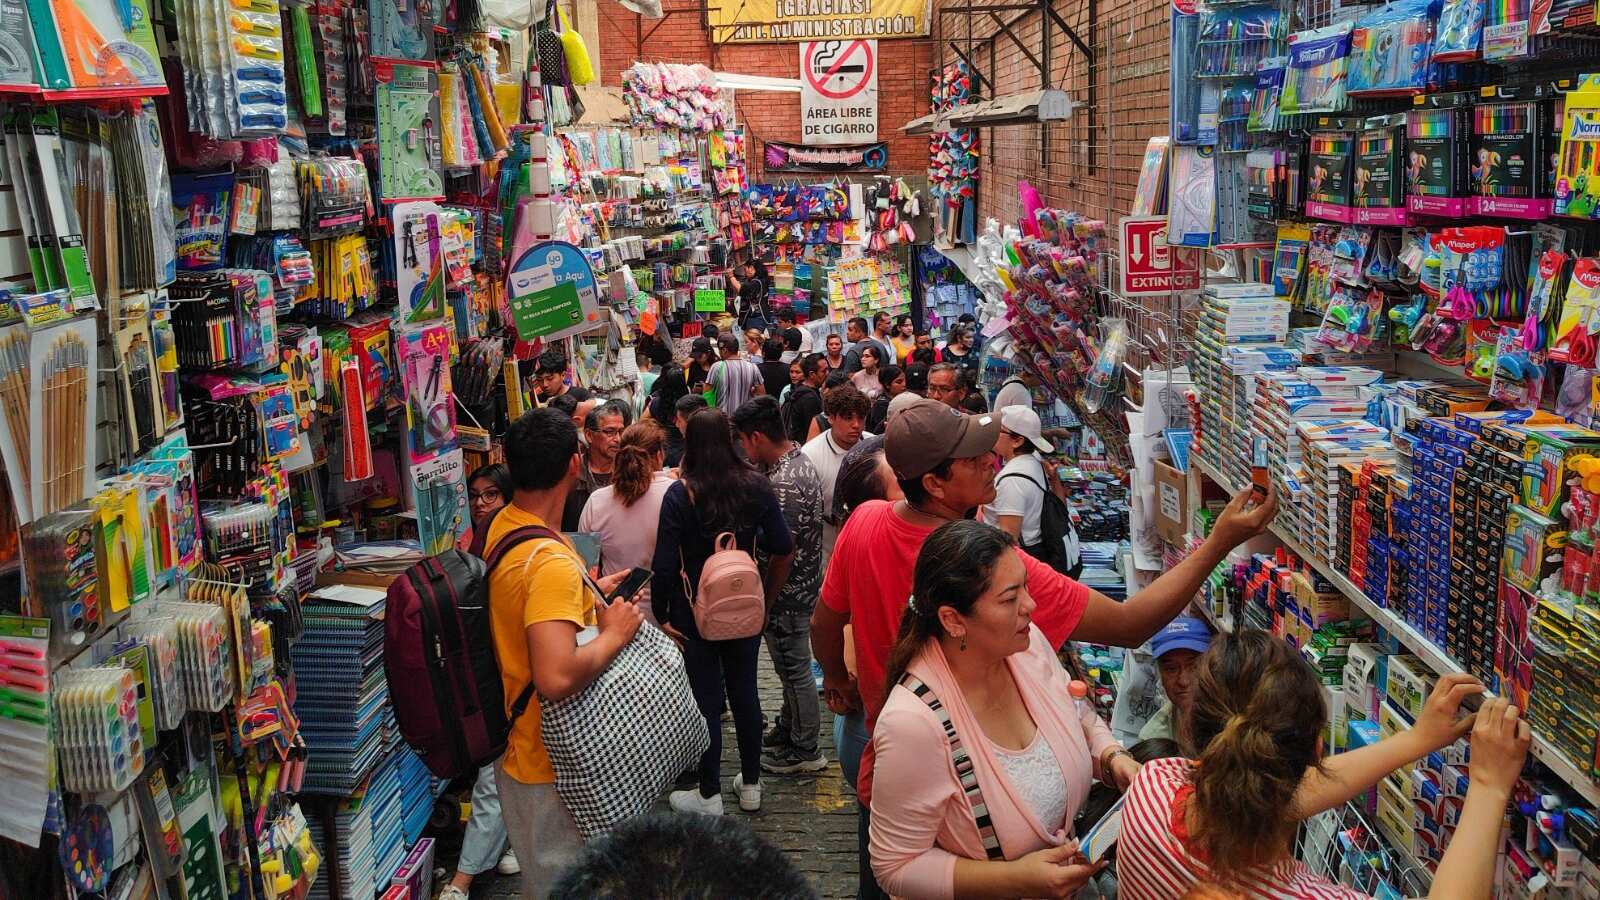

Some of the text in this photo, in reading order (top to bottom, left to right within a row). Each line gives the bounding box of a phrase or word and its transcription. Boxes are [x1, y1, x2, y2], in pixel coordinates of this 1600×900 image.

[807, 107, 873, 119] ÁREA LIBRE
[805, 123, 875, 135] DE CIGARRO
[1482, 199, 1496, 212] 24
[1360, 210, 1370, 221] 36
[1447, 240, 1476, 249] Maped
[1132, 275, 1194, 288] EXTINTOR
[426, 331, 446, 348] A+
[417, 462, 458, 482] Barrilito
